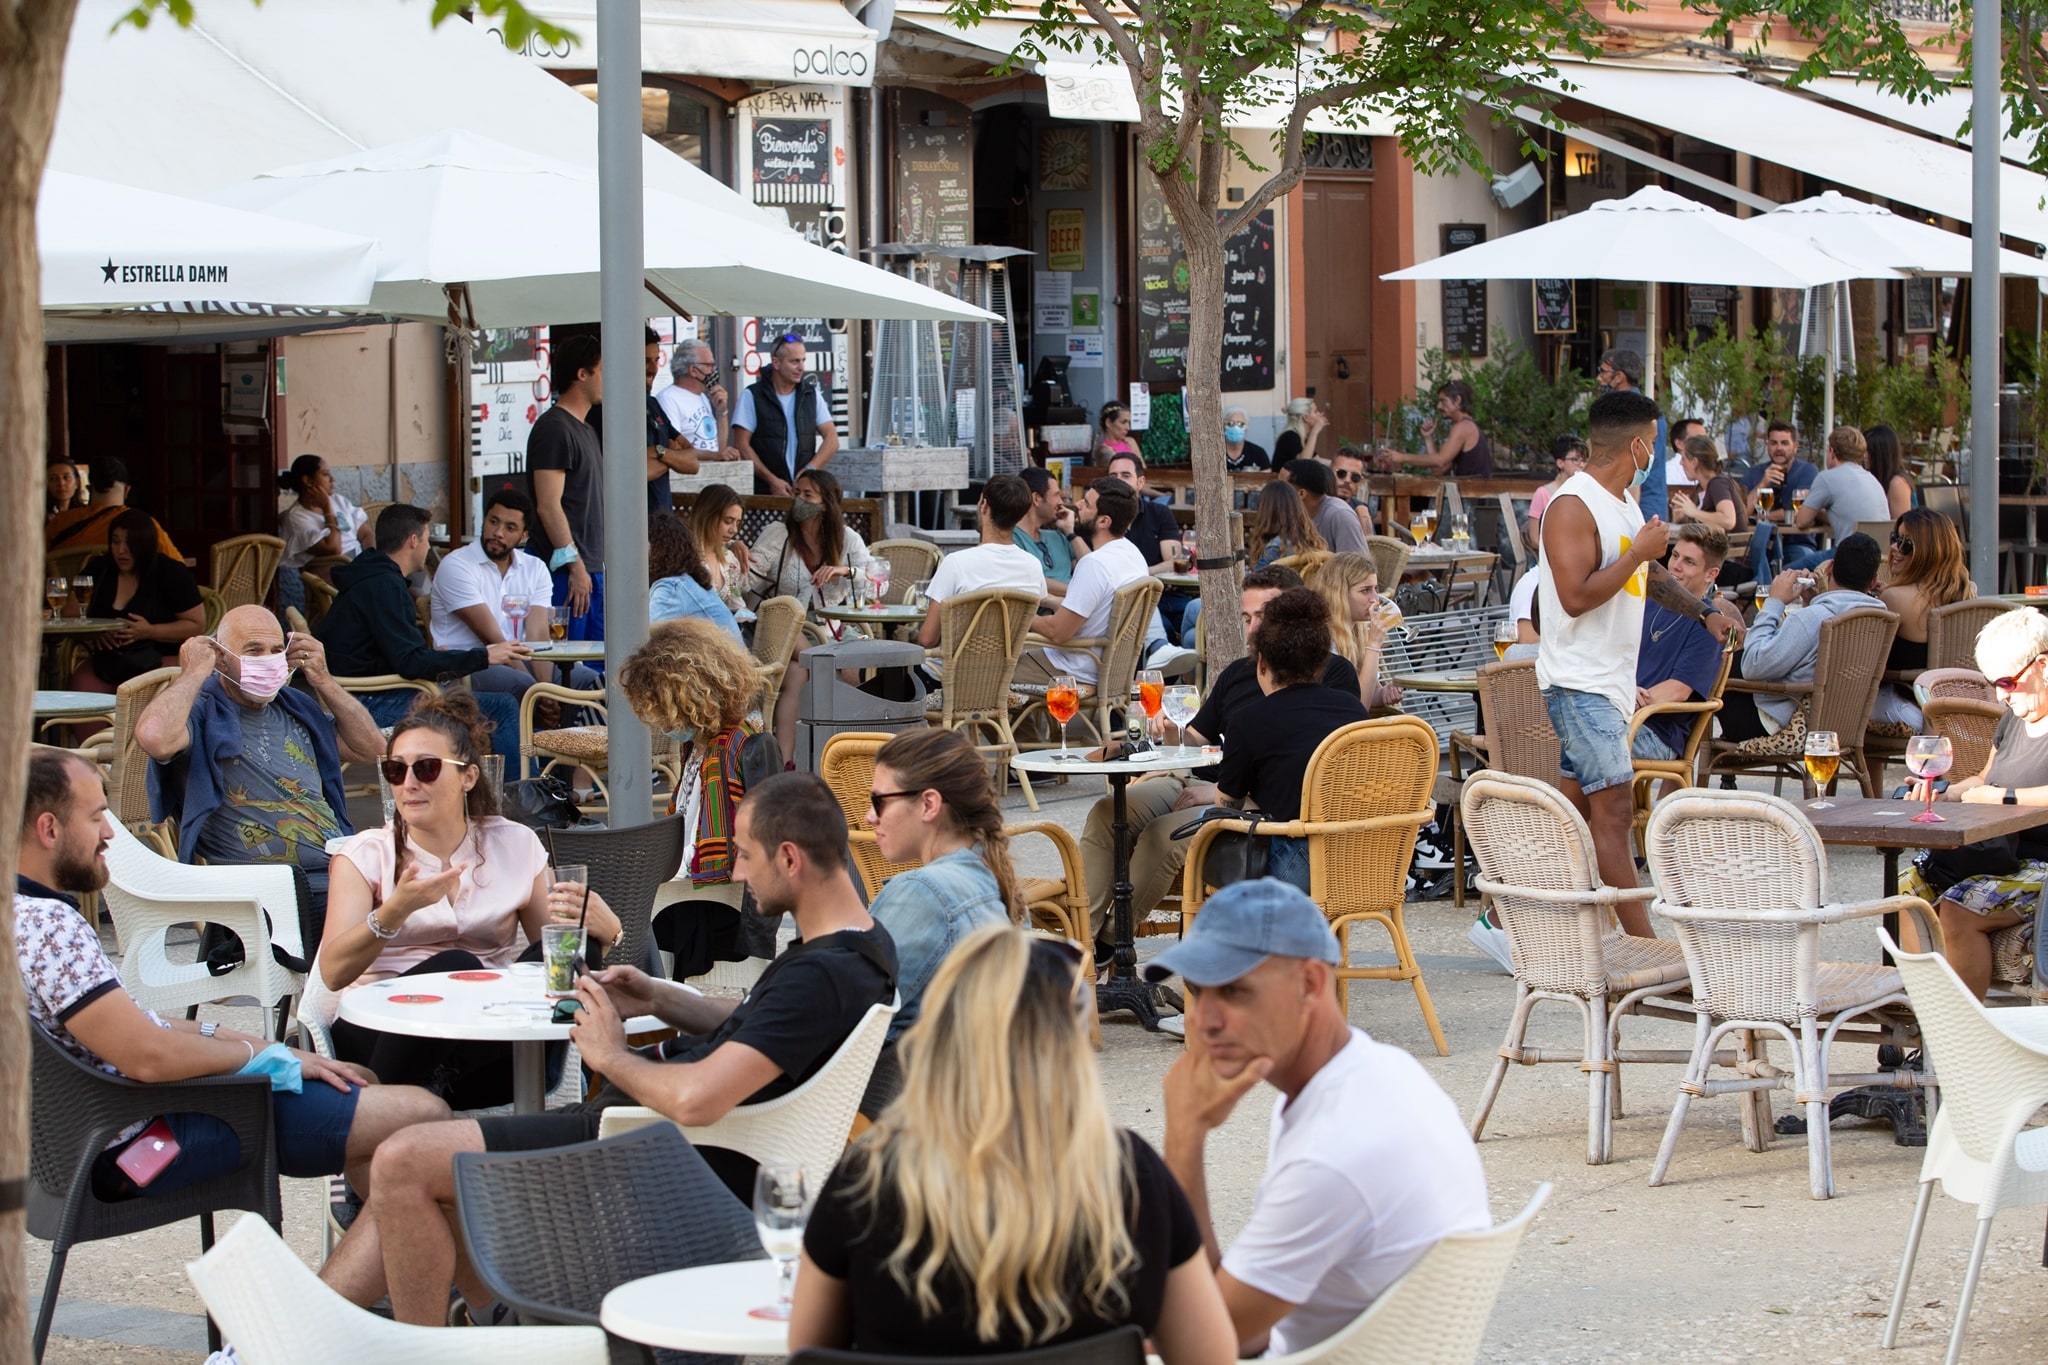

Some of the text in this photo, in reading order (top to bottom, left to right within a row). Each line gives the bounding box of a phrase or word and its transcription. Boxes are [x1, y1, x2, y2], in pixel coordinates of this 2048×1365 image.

[793, 44, 867, 78] palco
[769, 91, 797, 112] PASA
[760, 130, 819, 153] Bienvenidos
[912, 160, 959, 172] DESAYUNOS
[1050, 227, 1081, 253] BEER
[122, 265, 228, 283] ESTRELLA DAMM
[495, 385, 516, 404] Tapas
